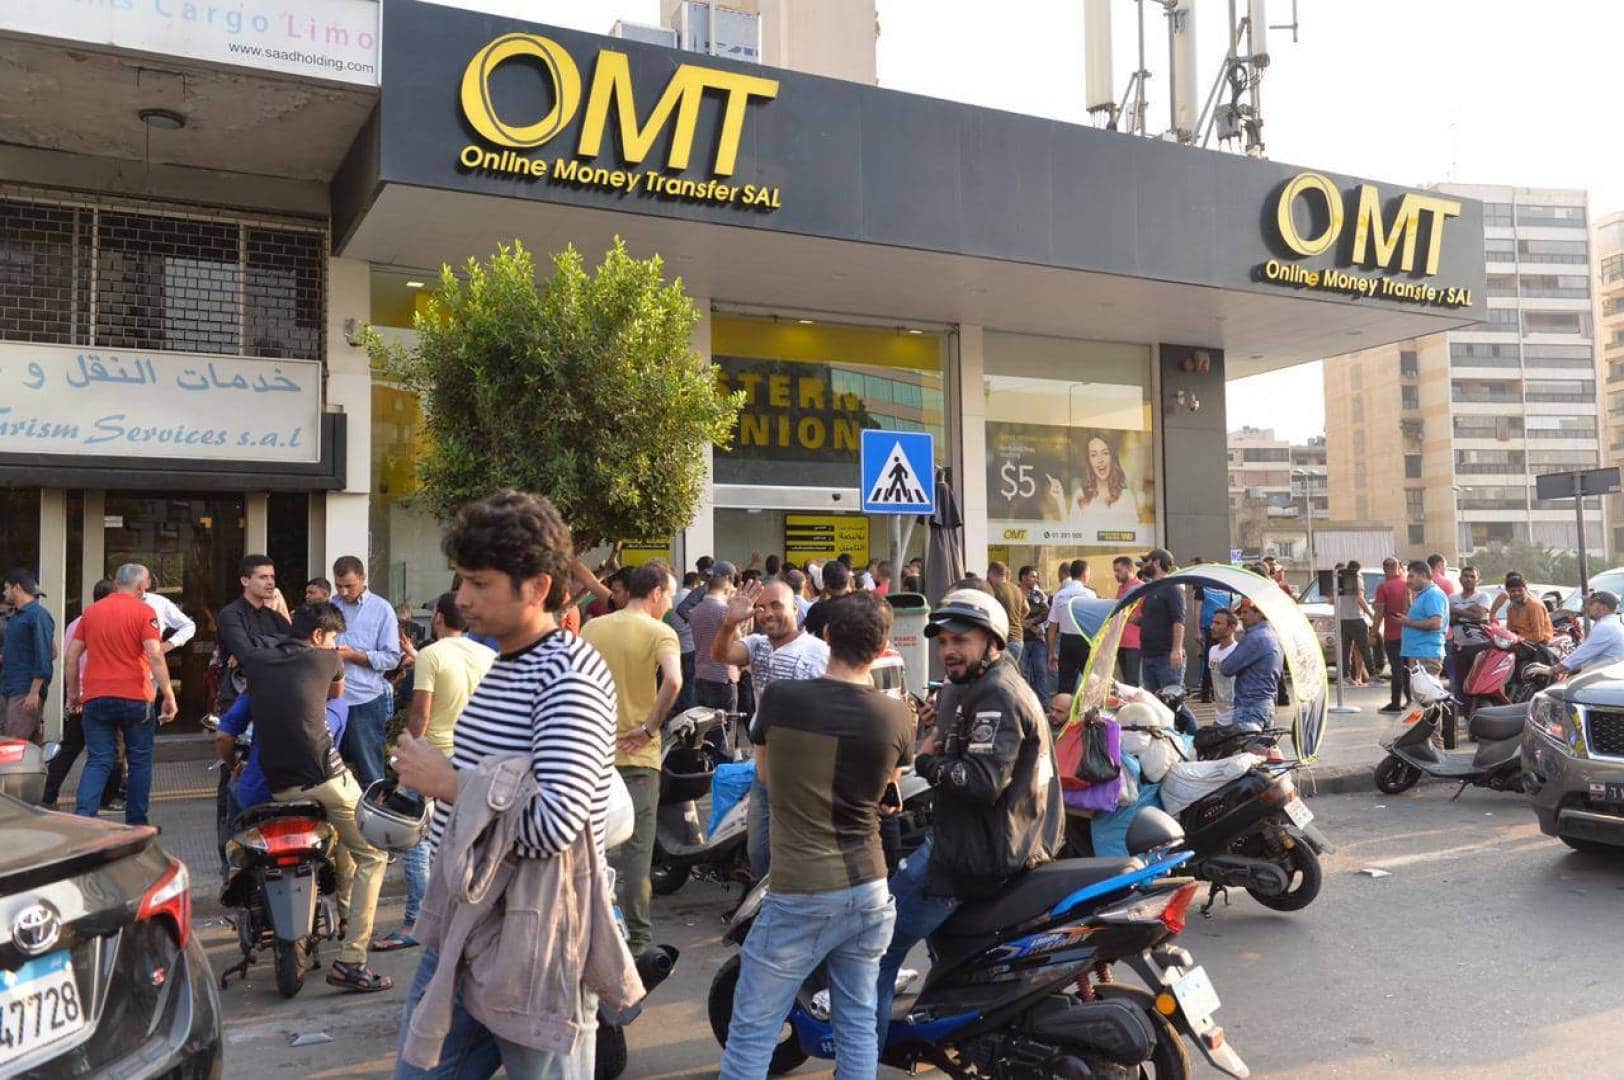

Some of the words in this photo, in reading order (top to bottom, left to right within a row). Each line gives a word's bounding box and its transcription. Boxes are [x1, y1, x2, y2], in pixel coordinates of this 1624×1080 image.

[287, 14, 374, 50] Limo
[229, 41, 374, 74] www.saadholding.com
[461, 32, 779, 177] OMT
[460, 145, 548, 176] Online
[553, 158, 641, 192] Money
[646, 171, 739, 203] Transfer
[741, 183, 782, 208] SAL
[1277, 171, 1462, 276] OMT
[1265, 259, 1319, 287] Online
[1323, 269, 1379, 297] Money
[1446, 287, 1473, 306] SAL
[23, 360, 46, 390] و
[66, 354, 157, 388] النقل
[176, 362, 301, 392] خدمات
[84, 413, 228, 447] Services
[236, 426, 303, 448] s.a.l
[739, 412, 860, 452] NION
[1000, 460, 1036, 501] $5
[1003, 528, 1028, 541] OMT
